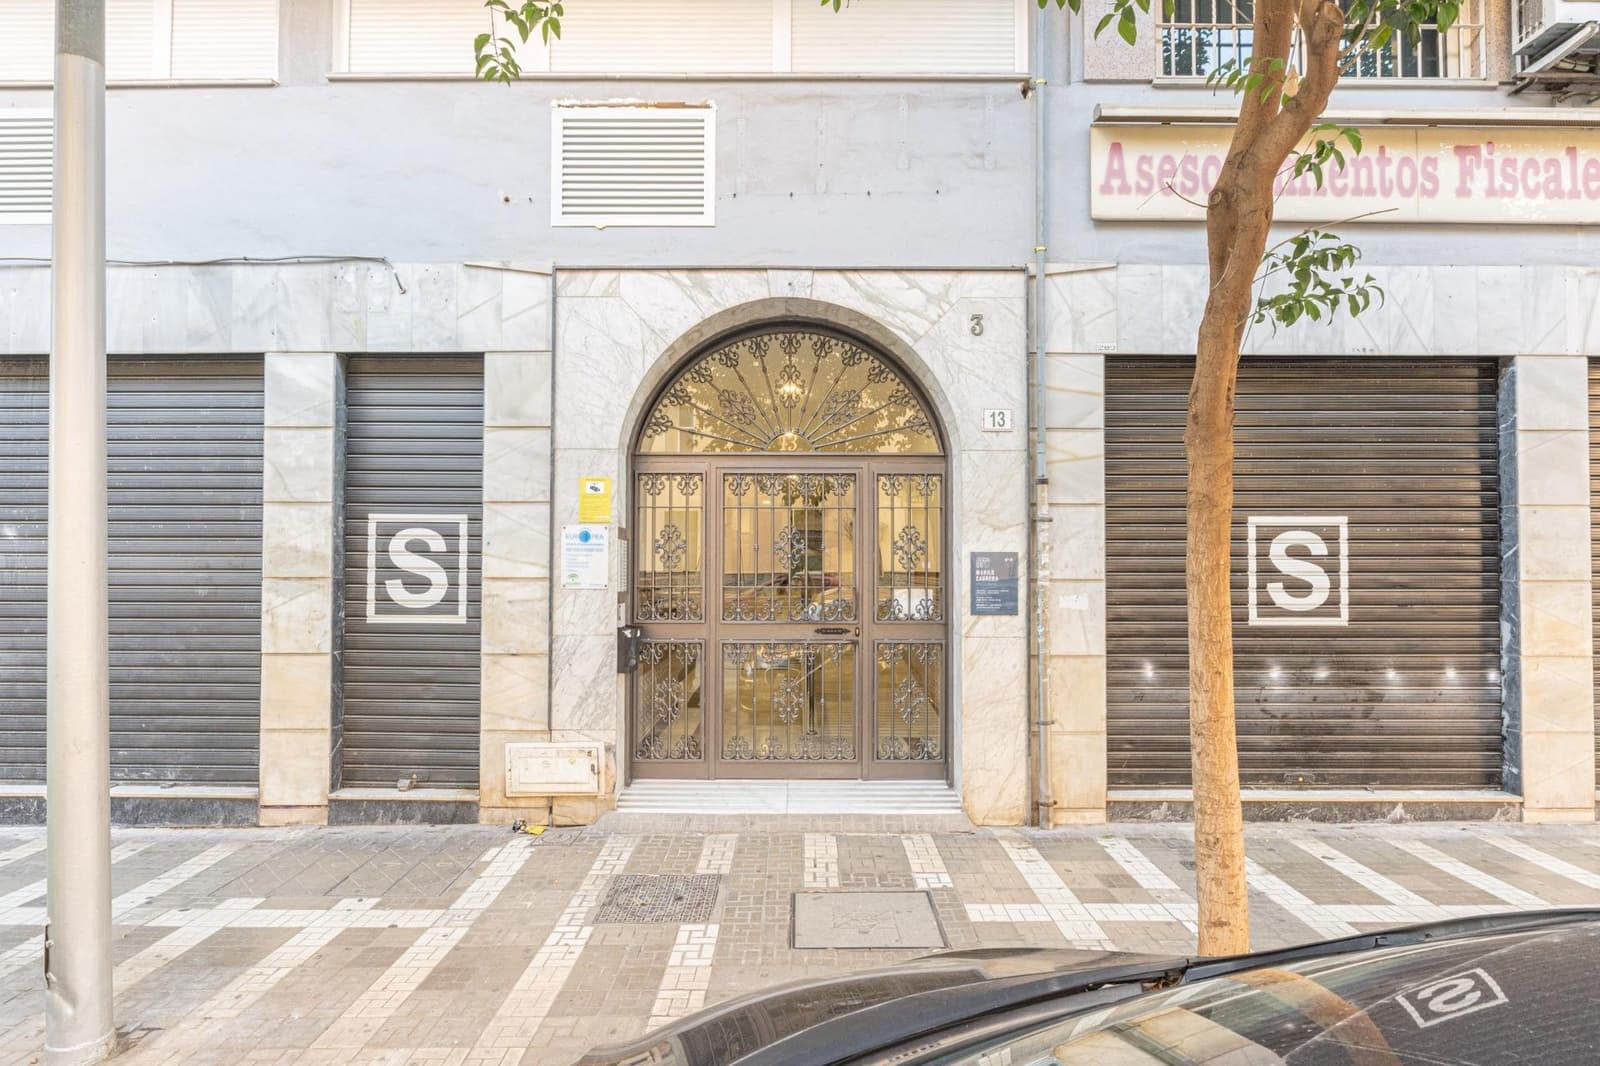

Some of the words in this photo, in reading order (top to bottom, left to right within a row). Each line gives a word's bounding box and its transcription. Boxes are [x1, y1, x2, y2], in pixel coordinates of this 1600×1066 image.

[970, 313, 984, 337] 3
[989, 411, 1006, 428] 13
[384, 527, 449, 609] S
[1266, 530, 1331, 612] S
